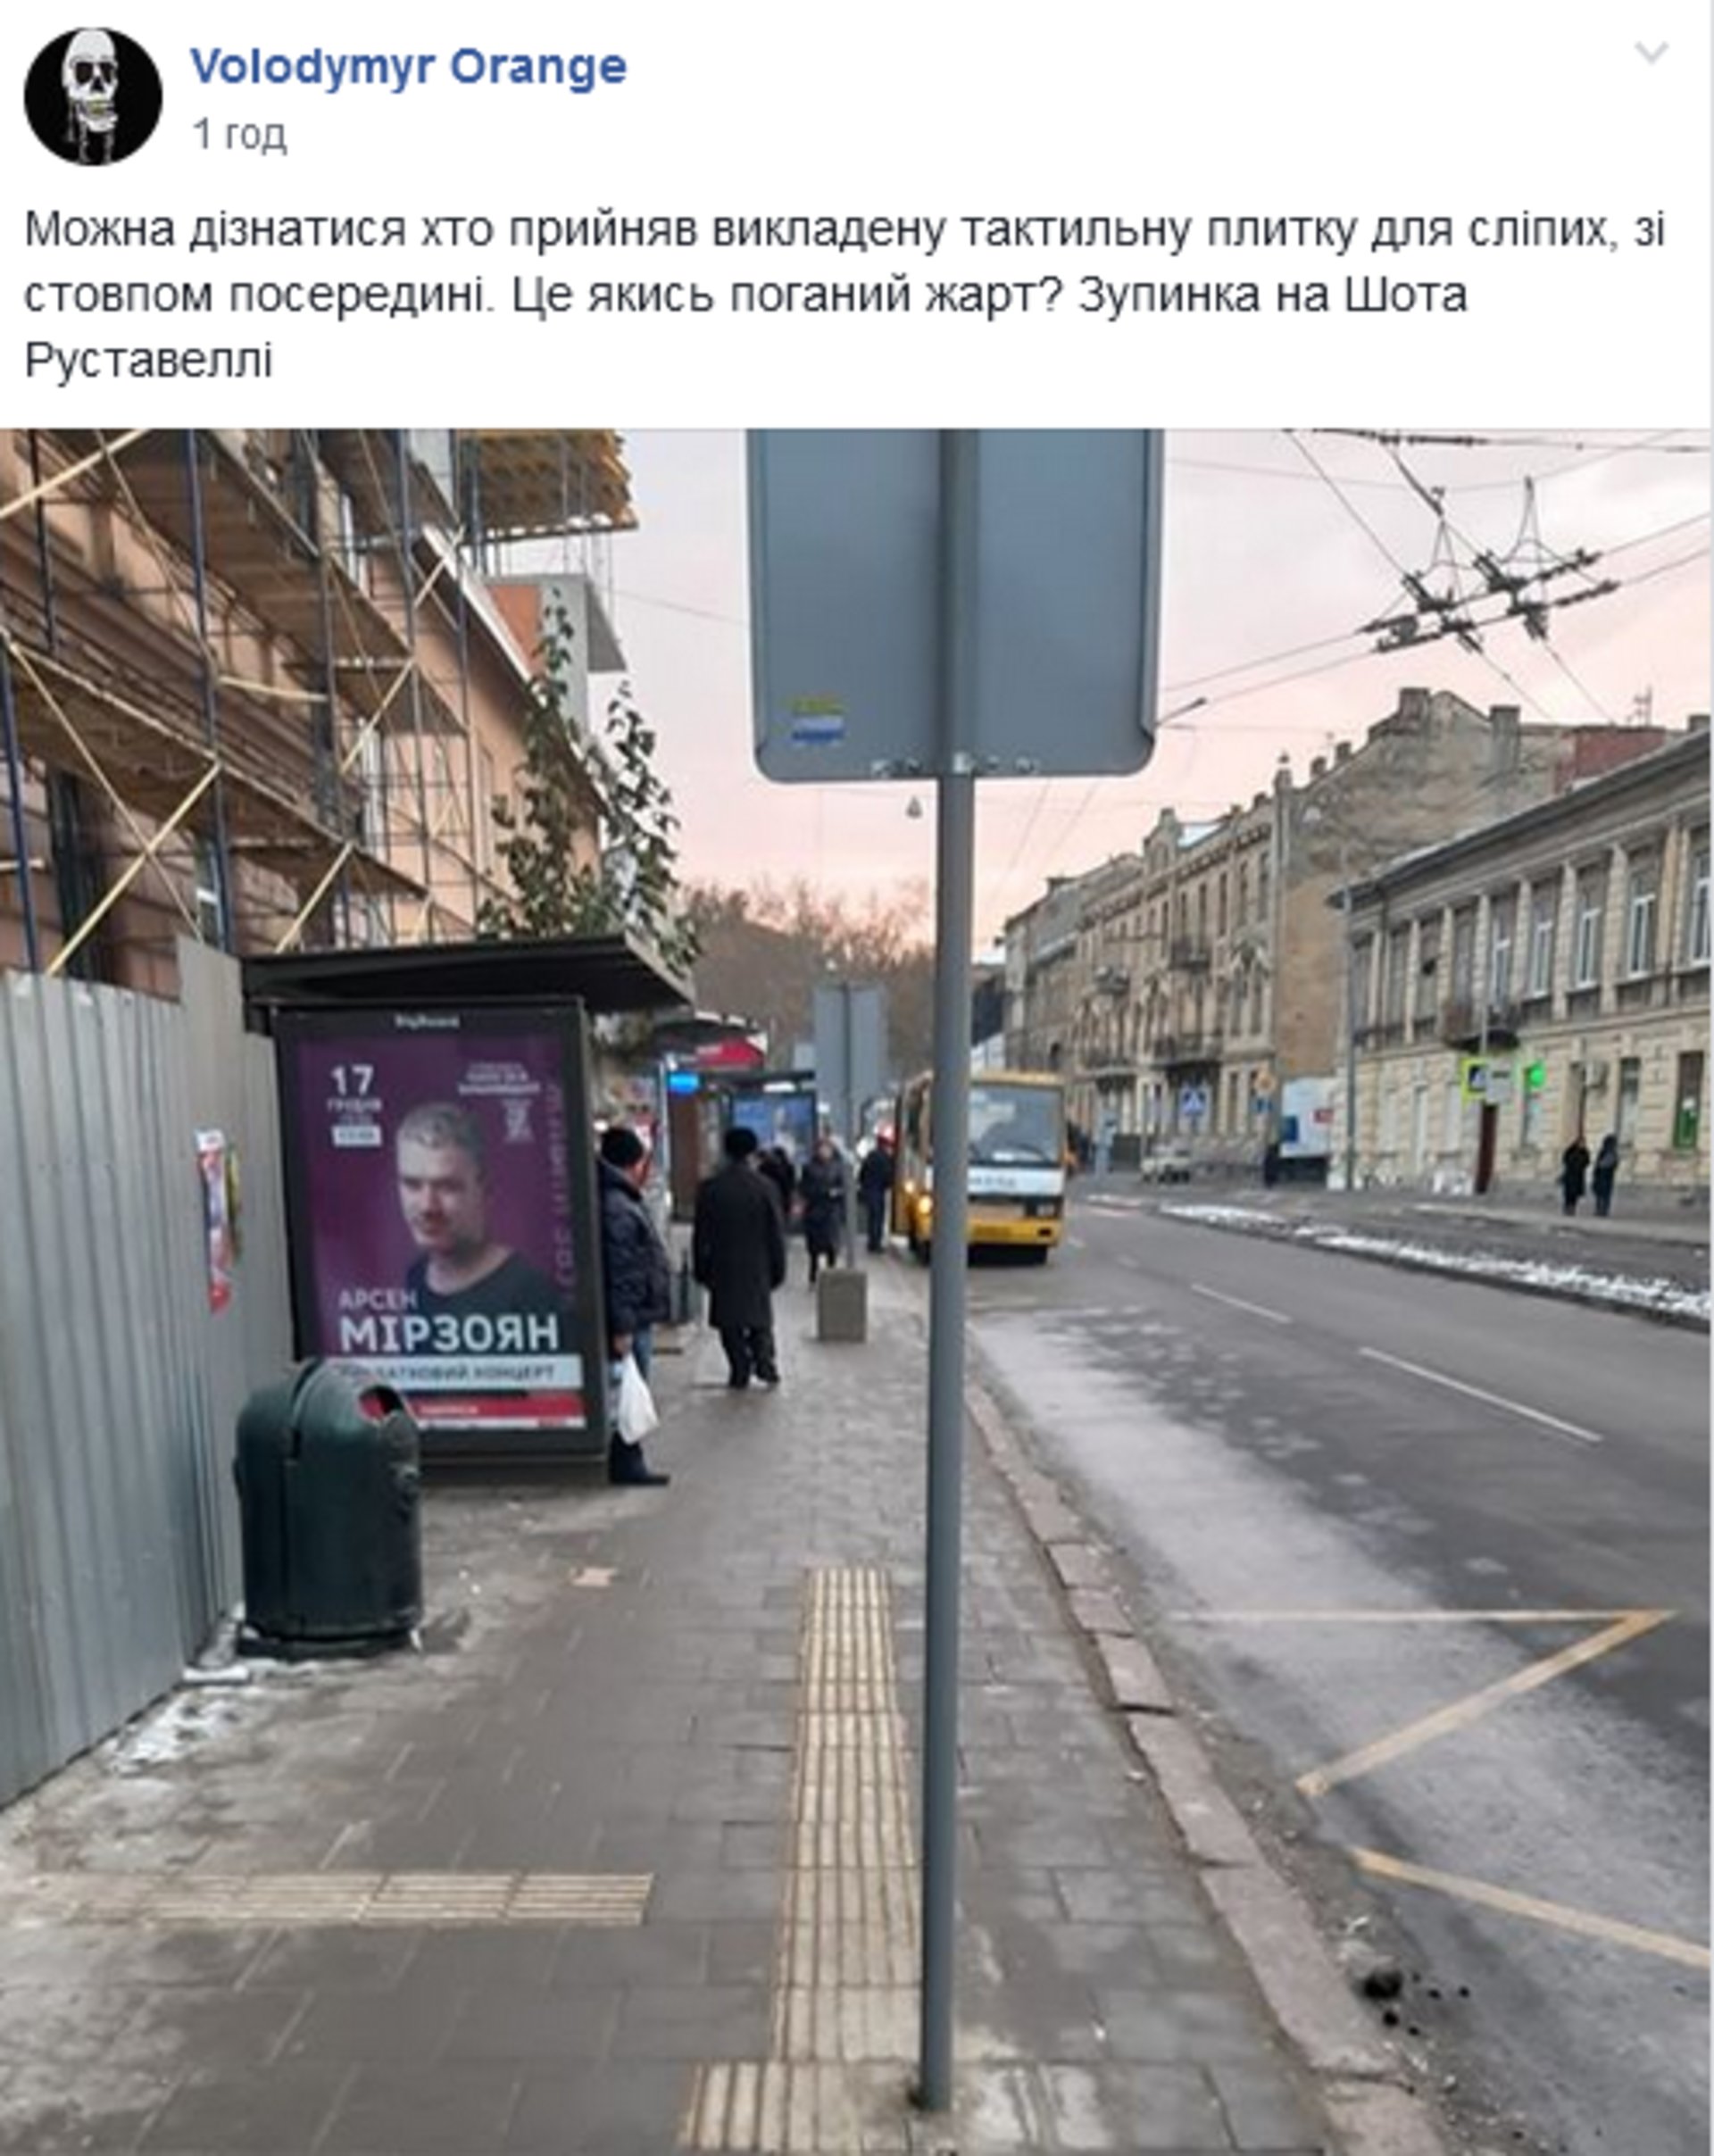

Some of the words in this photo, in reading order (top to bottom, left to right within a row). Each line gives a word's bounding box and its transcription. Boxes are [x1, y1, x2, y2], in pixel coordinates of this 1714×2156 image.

[331, 1064, 374, 1095] 17
[339, 1288, 418, 1311] АРСЕН
[340, 1312, 560, 1353] МІРЗОЯН
